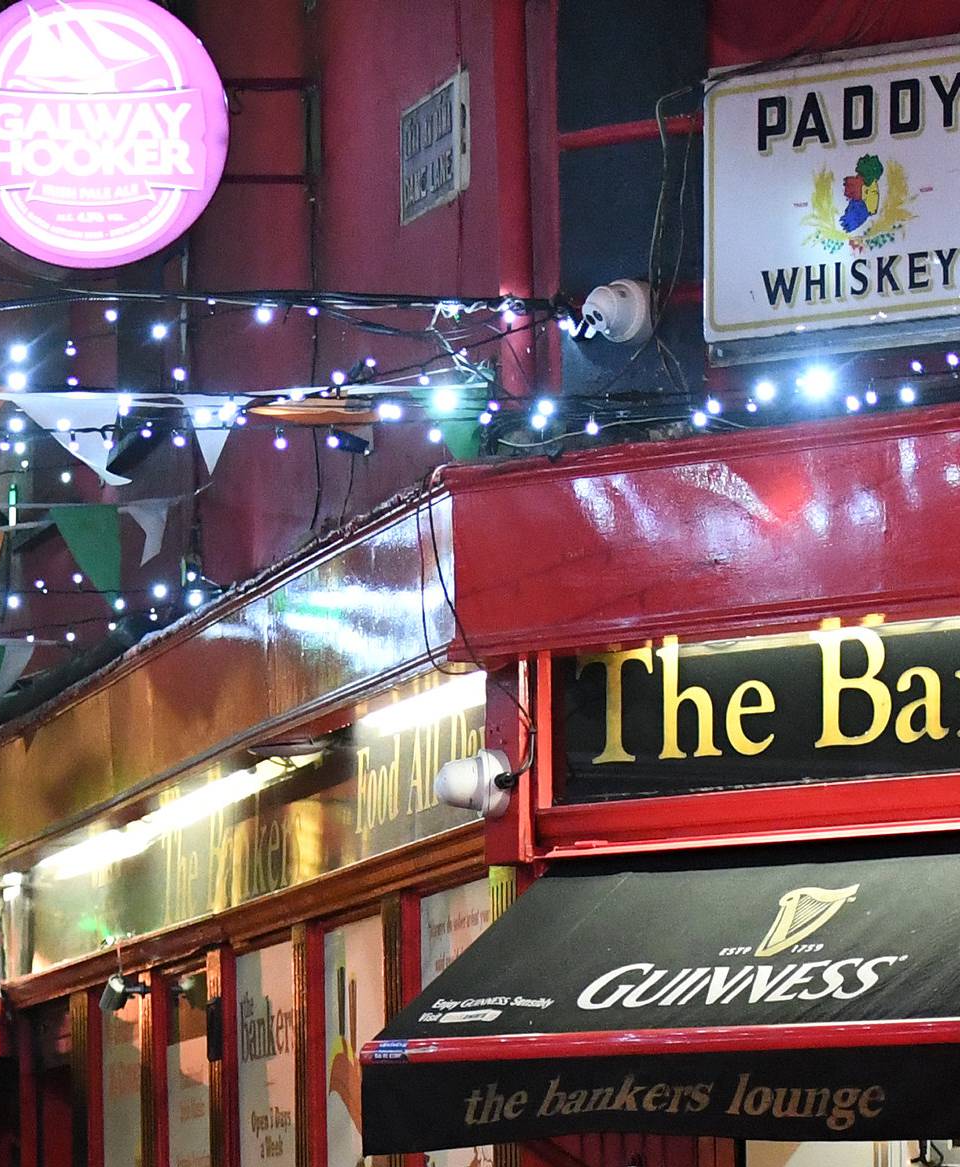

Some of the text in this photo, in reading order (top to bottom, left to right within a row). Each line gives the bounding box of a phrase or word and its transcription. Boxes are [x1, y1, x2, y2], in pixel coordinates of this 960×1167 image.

[758, 72, 960, 152] PADDY
[761, 248, 959, 306] WHISKEY
[576, 628, 960, 765] The Ba
[355, 733, 401, 834] Food
[406, 720, 440, 815] All
[791, 944, 825, 954] 1759
[431, 998, 461, 1010] Enjoy
[460, 997, 512, 1008] GUINNESS
[577, 956, 900, 1010] GUINNESS
[418, 1011, 442, 1023] Visit
[251, 1110, 269, 1142] Open
[463, 1072, 887, 1131] the bankers lounge
